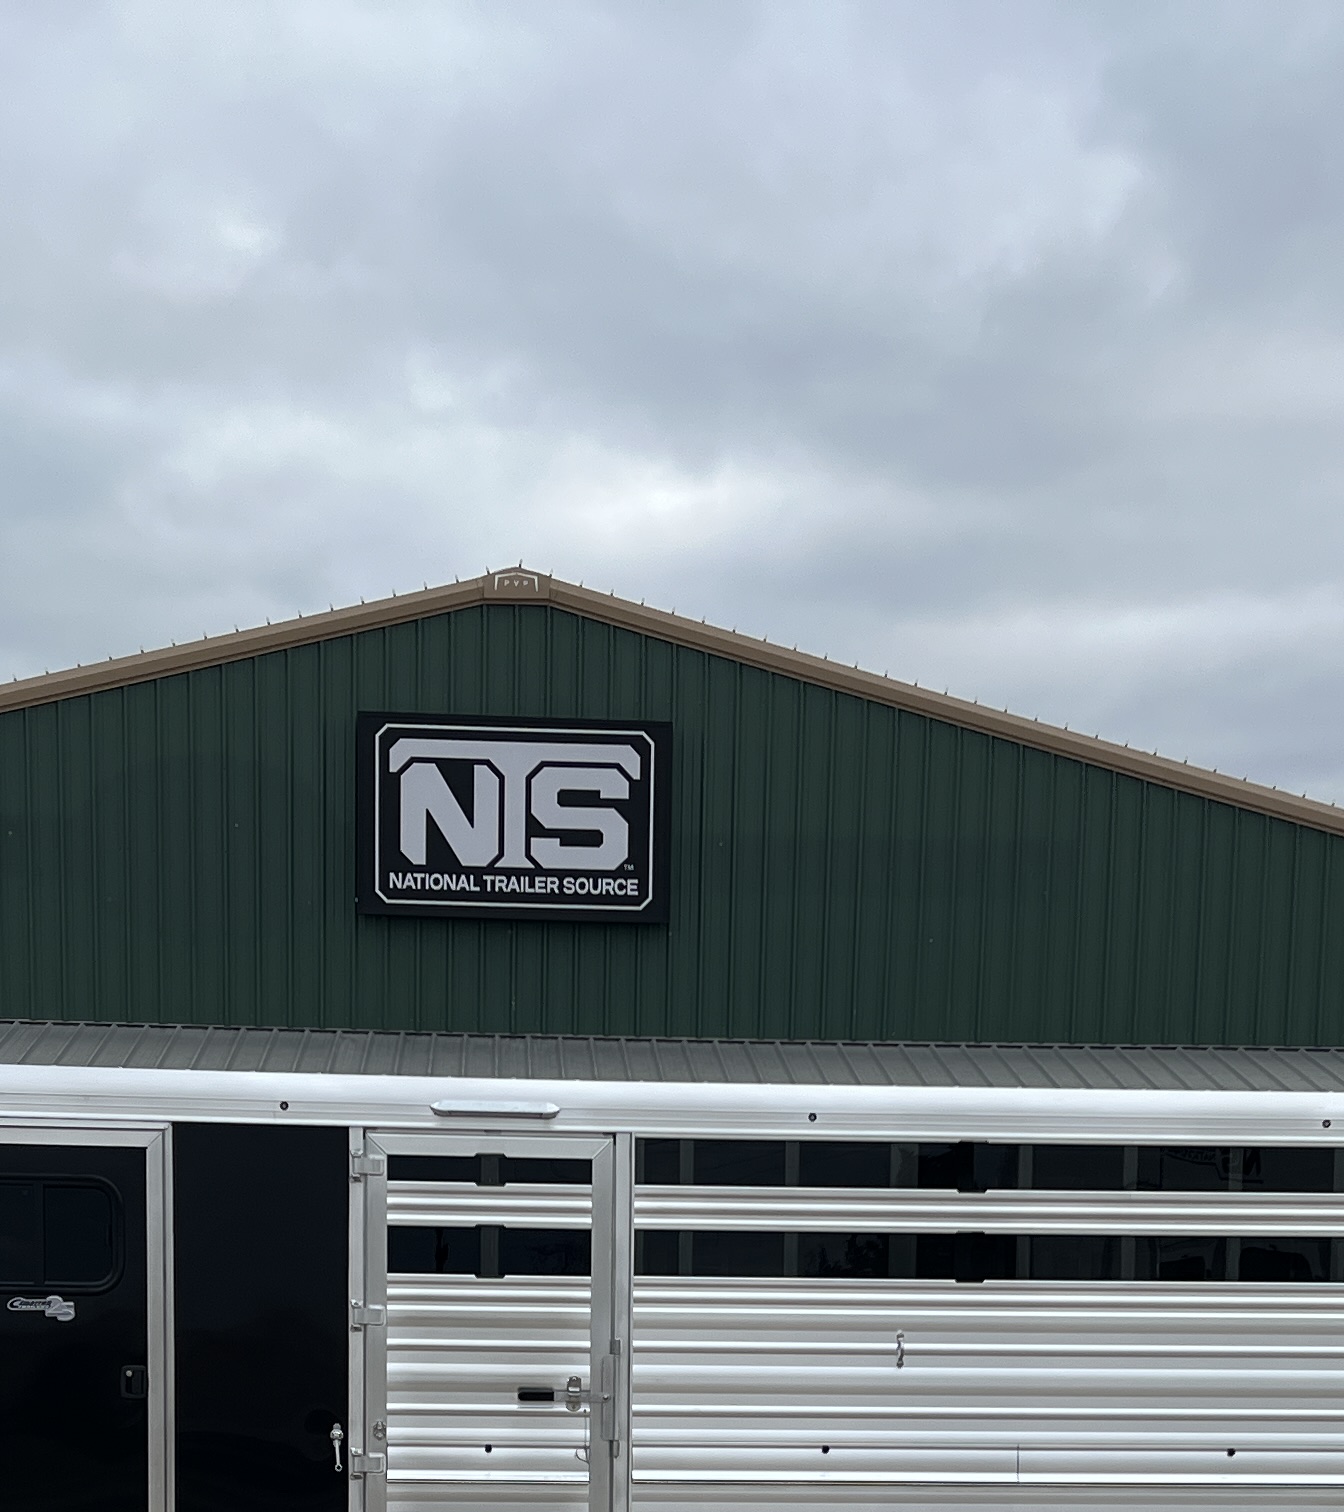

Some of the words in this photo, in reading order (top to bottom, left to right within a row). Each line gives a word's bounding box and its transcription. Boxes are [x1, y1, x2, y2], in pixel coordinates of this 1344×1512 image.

[389, 738, 641, 871] NTS
[389, 872, 480, 892] NATIONAL
[483, 875, 559, 894] TRAILER
[563, 877, 639, 896] SOURCE
